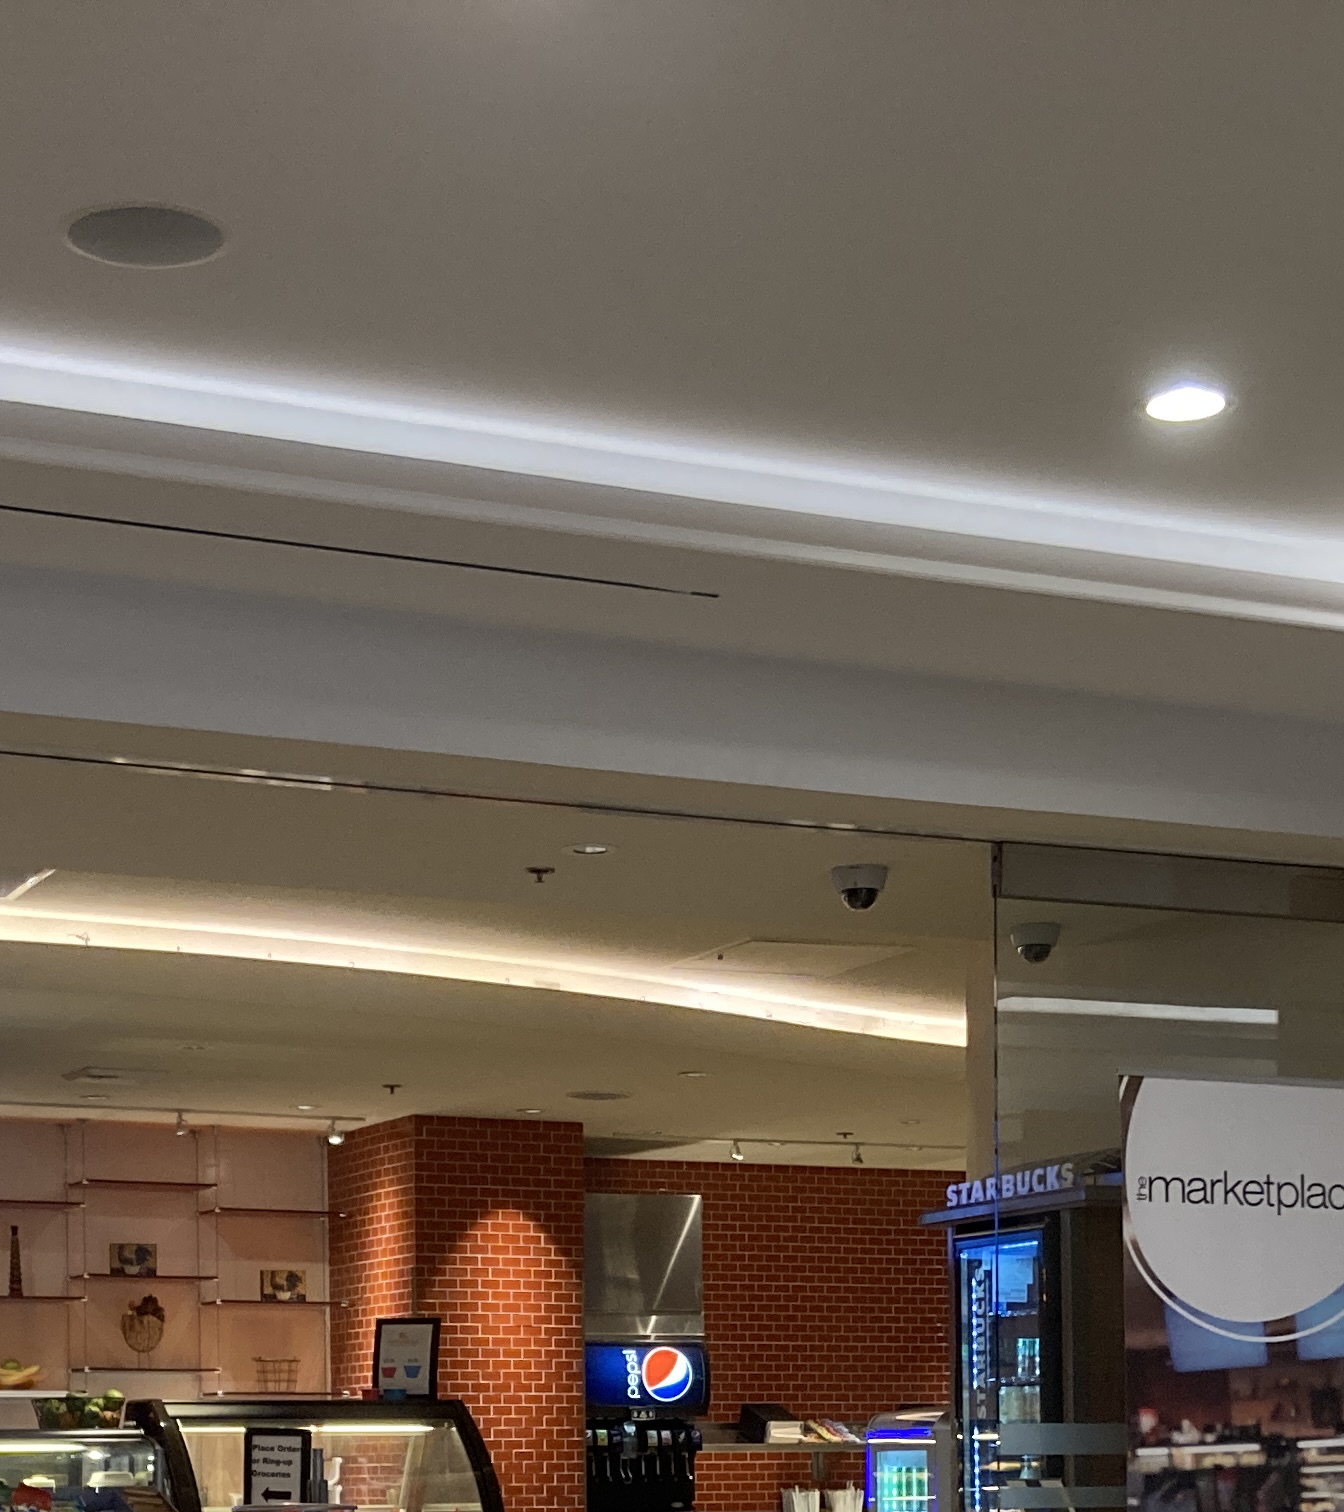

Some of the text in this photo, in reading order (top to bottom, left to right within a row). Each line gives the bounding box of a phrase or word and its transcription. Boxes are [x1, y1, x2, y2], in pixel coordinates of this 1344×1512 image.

[946, 1162, 1074, 1208] STARBUCKS
[1136, 1175, 1148, 1201] the
[974, 1265, 988, 1420] STARBUCKS
[622, 1349, 641, 1399] pepsi
[252, 1444, 275, 1452] Place
[251, 1469, 291, 1478] Groceries
